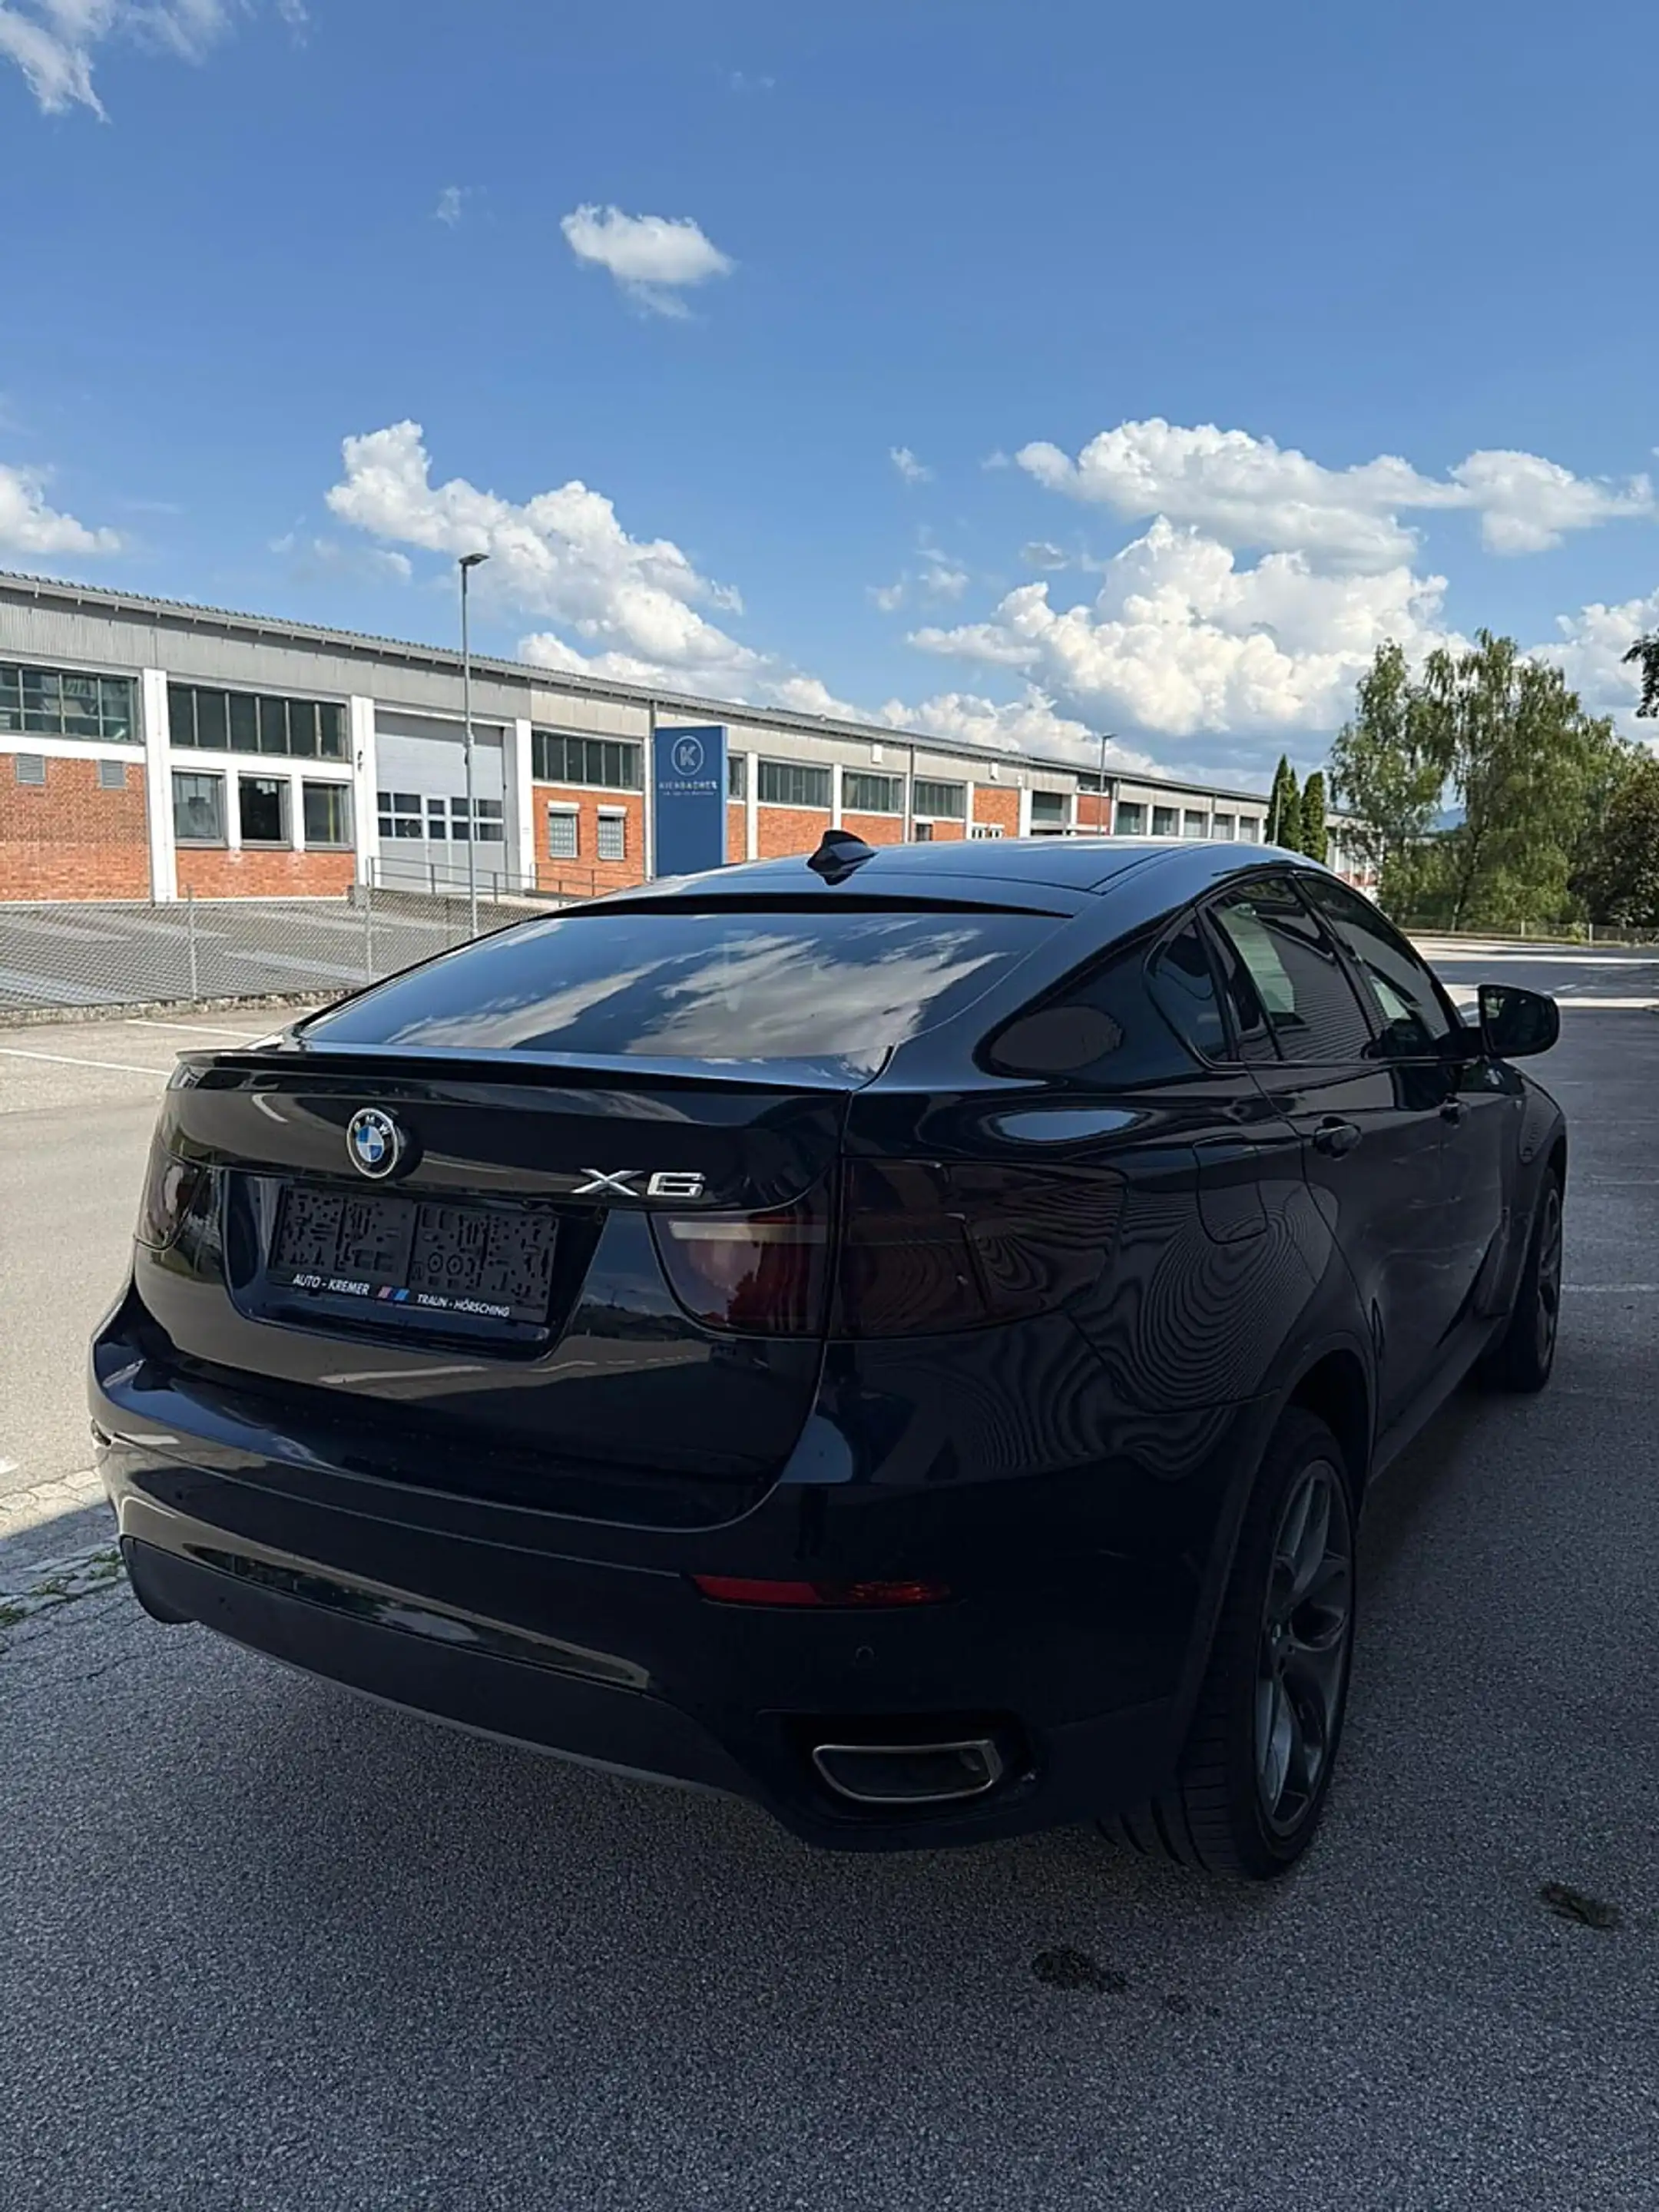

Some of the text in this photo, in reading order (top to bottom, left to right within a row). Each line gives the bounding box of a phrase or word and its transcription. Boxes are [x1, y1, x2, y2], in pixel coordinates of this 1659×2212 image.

[680, 746, 697, 766] K
[354, 1114, 391, 1135] BMW
[571, 1167, 707, 1197] X6
[293, 1273, 321, 1288] AUTO
[327, 1278, 370, 1296] KREMER
[417, 1293, 449, 1307] TRAUN
[453, 1297, 510, 1317] HÖRSCHING
